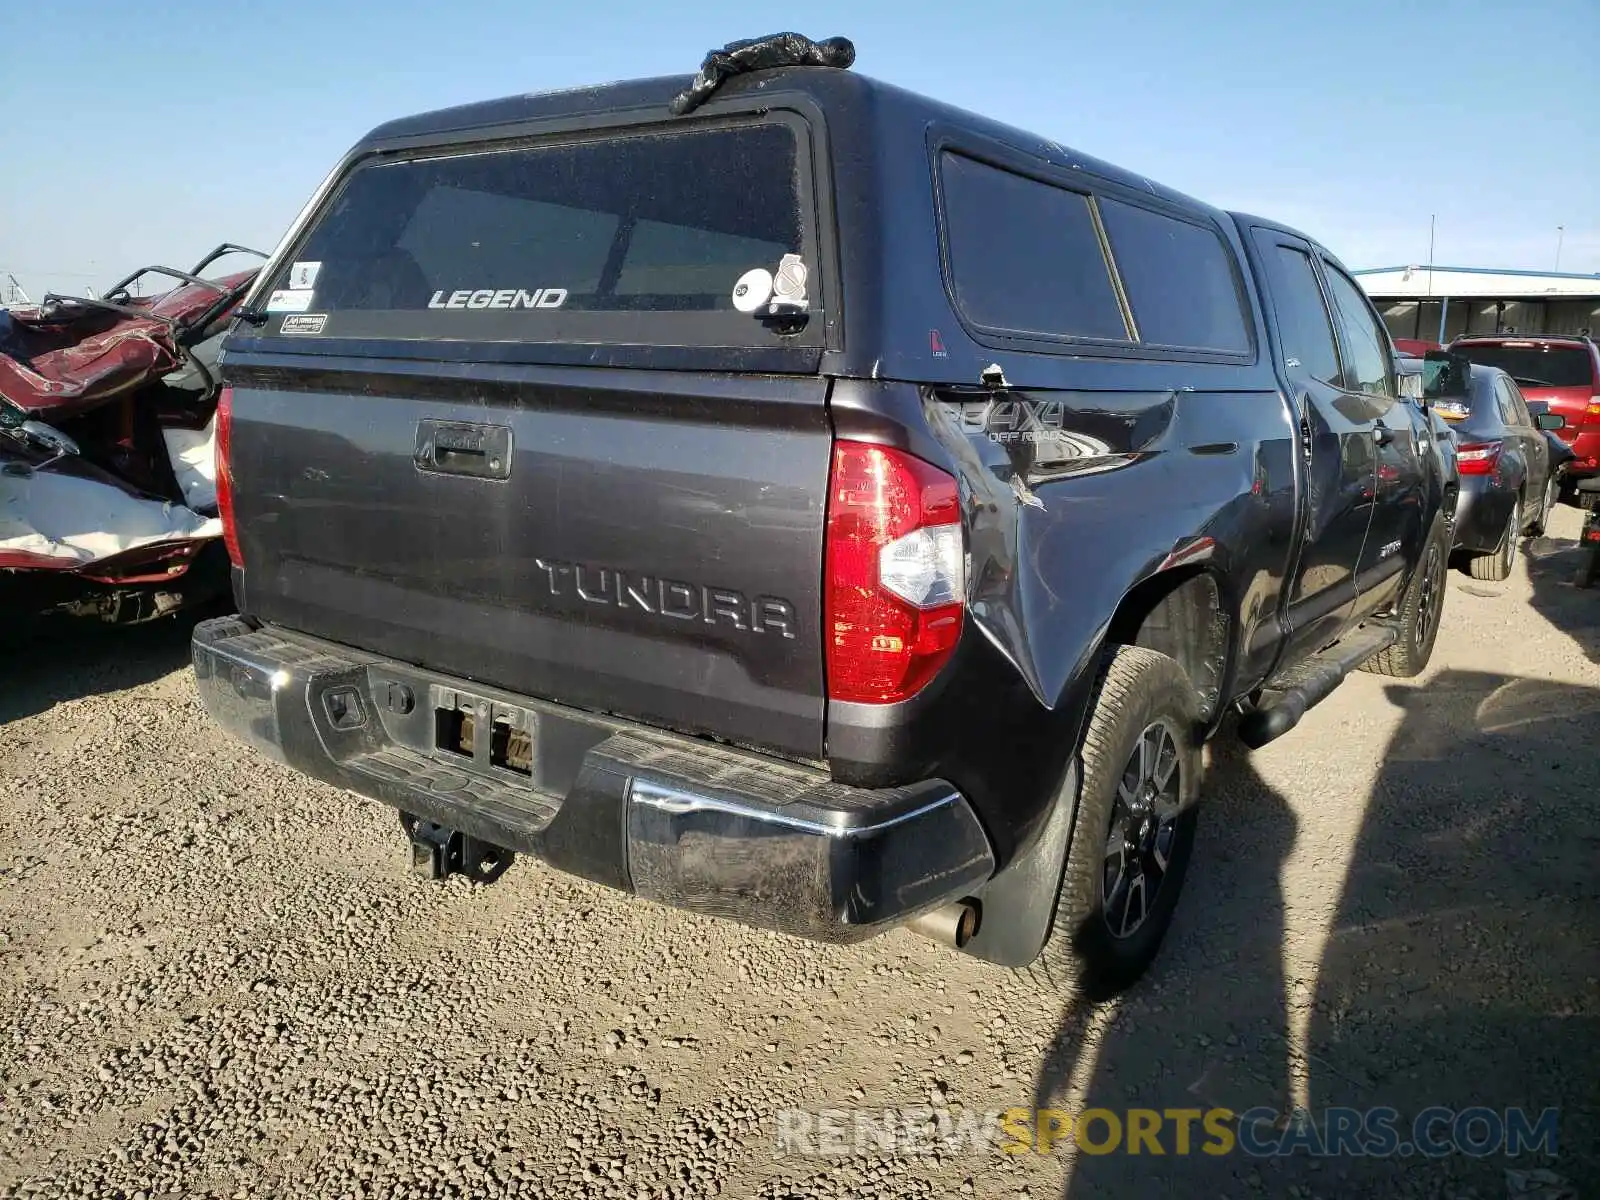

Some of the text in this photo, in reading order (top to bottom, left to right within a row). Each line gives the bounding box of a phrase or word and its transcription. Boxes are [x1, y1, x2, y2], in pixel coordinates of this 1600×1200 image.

[427, 288, 568, 309] LEGEND
[988, 430, 1061, 443] OFF ROAD
[534, 556, 797, 640] TUNDRA
